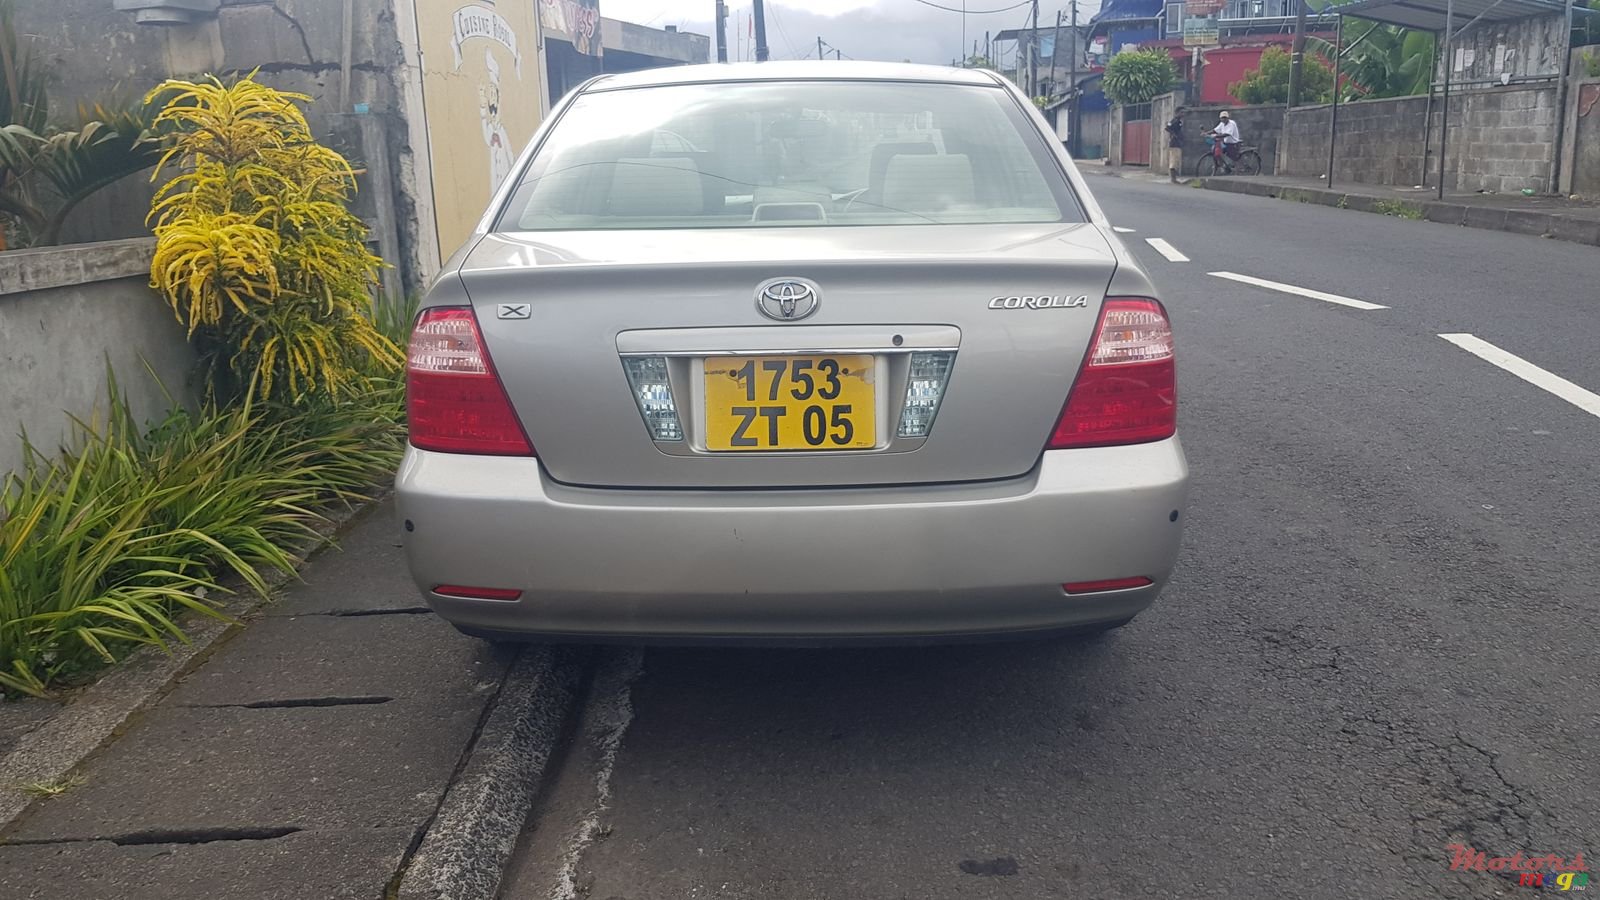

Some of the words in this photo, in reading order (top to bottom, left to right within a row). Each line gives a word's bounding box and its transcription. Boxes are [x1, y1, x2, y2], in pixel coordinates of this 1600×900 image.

[502, 305, 526, 317] X
[988, 295, 1088, 310] COROLLA
[738, 359, 841, 401] 1753
[731, 406, 786, 446] ZT
[803, 404, 854, 446] 05
